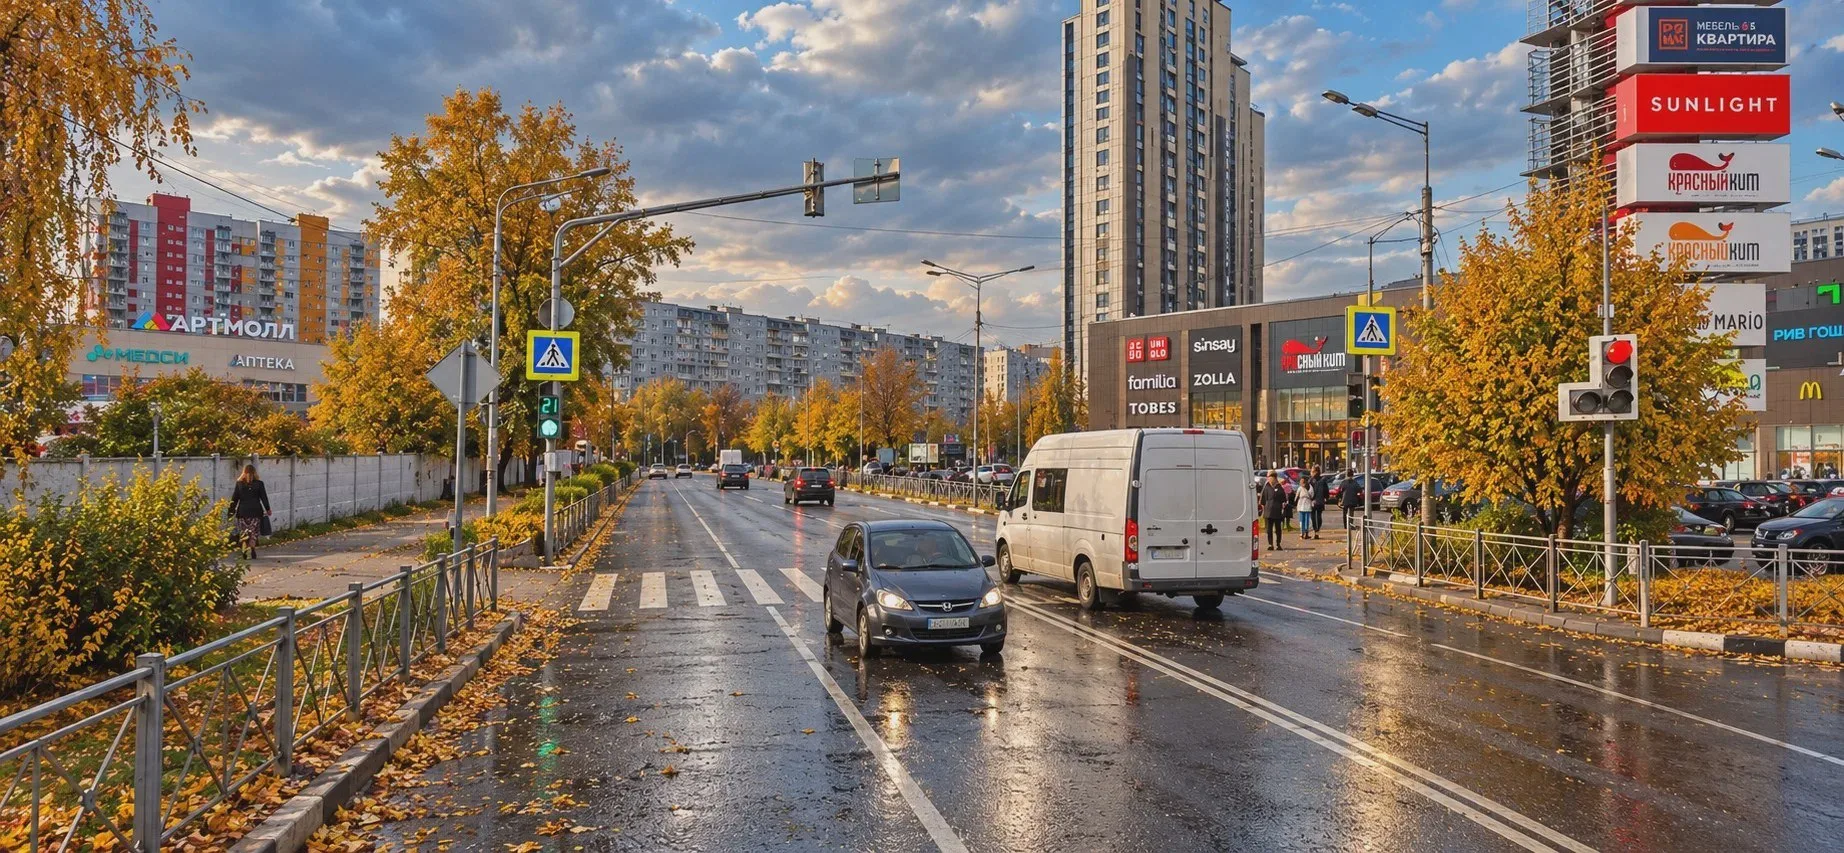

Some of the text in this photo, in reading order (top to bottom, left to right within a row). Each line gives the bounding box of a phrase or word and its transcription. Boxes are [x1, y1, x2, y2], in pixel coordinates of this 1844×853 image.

[1696, 21, 1740, 30] МЕБЕЛЬ
[1696, 33, 1776, 45] КВАРТИРА
[1651, 97, 1778, 112] SUNLIGHT
[169, 314, 295, 340] АРТМОЛЛ
[1773, 328, 1806, 341] РИВ
[1193, 337, 1236, 353] sinsay
[115, 347, 189, 365] МЕДСИ
[236, 354, 296, 370] АПТЕКА
[1128, 374, 1177, 390] familia
[1193, 372, 1237, 386] ZOLLA
[542, 397, 558, 414] 21
[1128, 402, 1177, 415] TOBES
